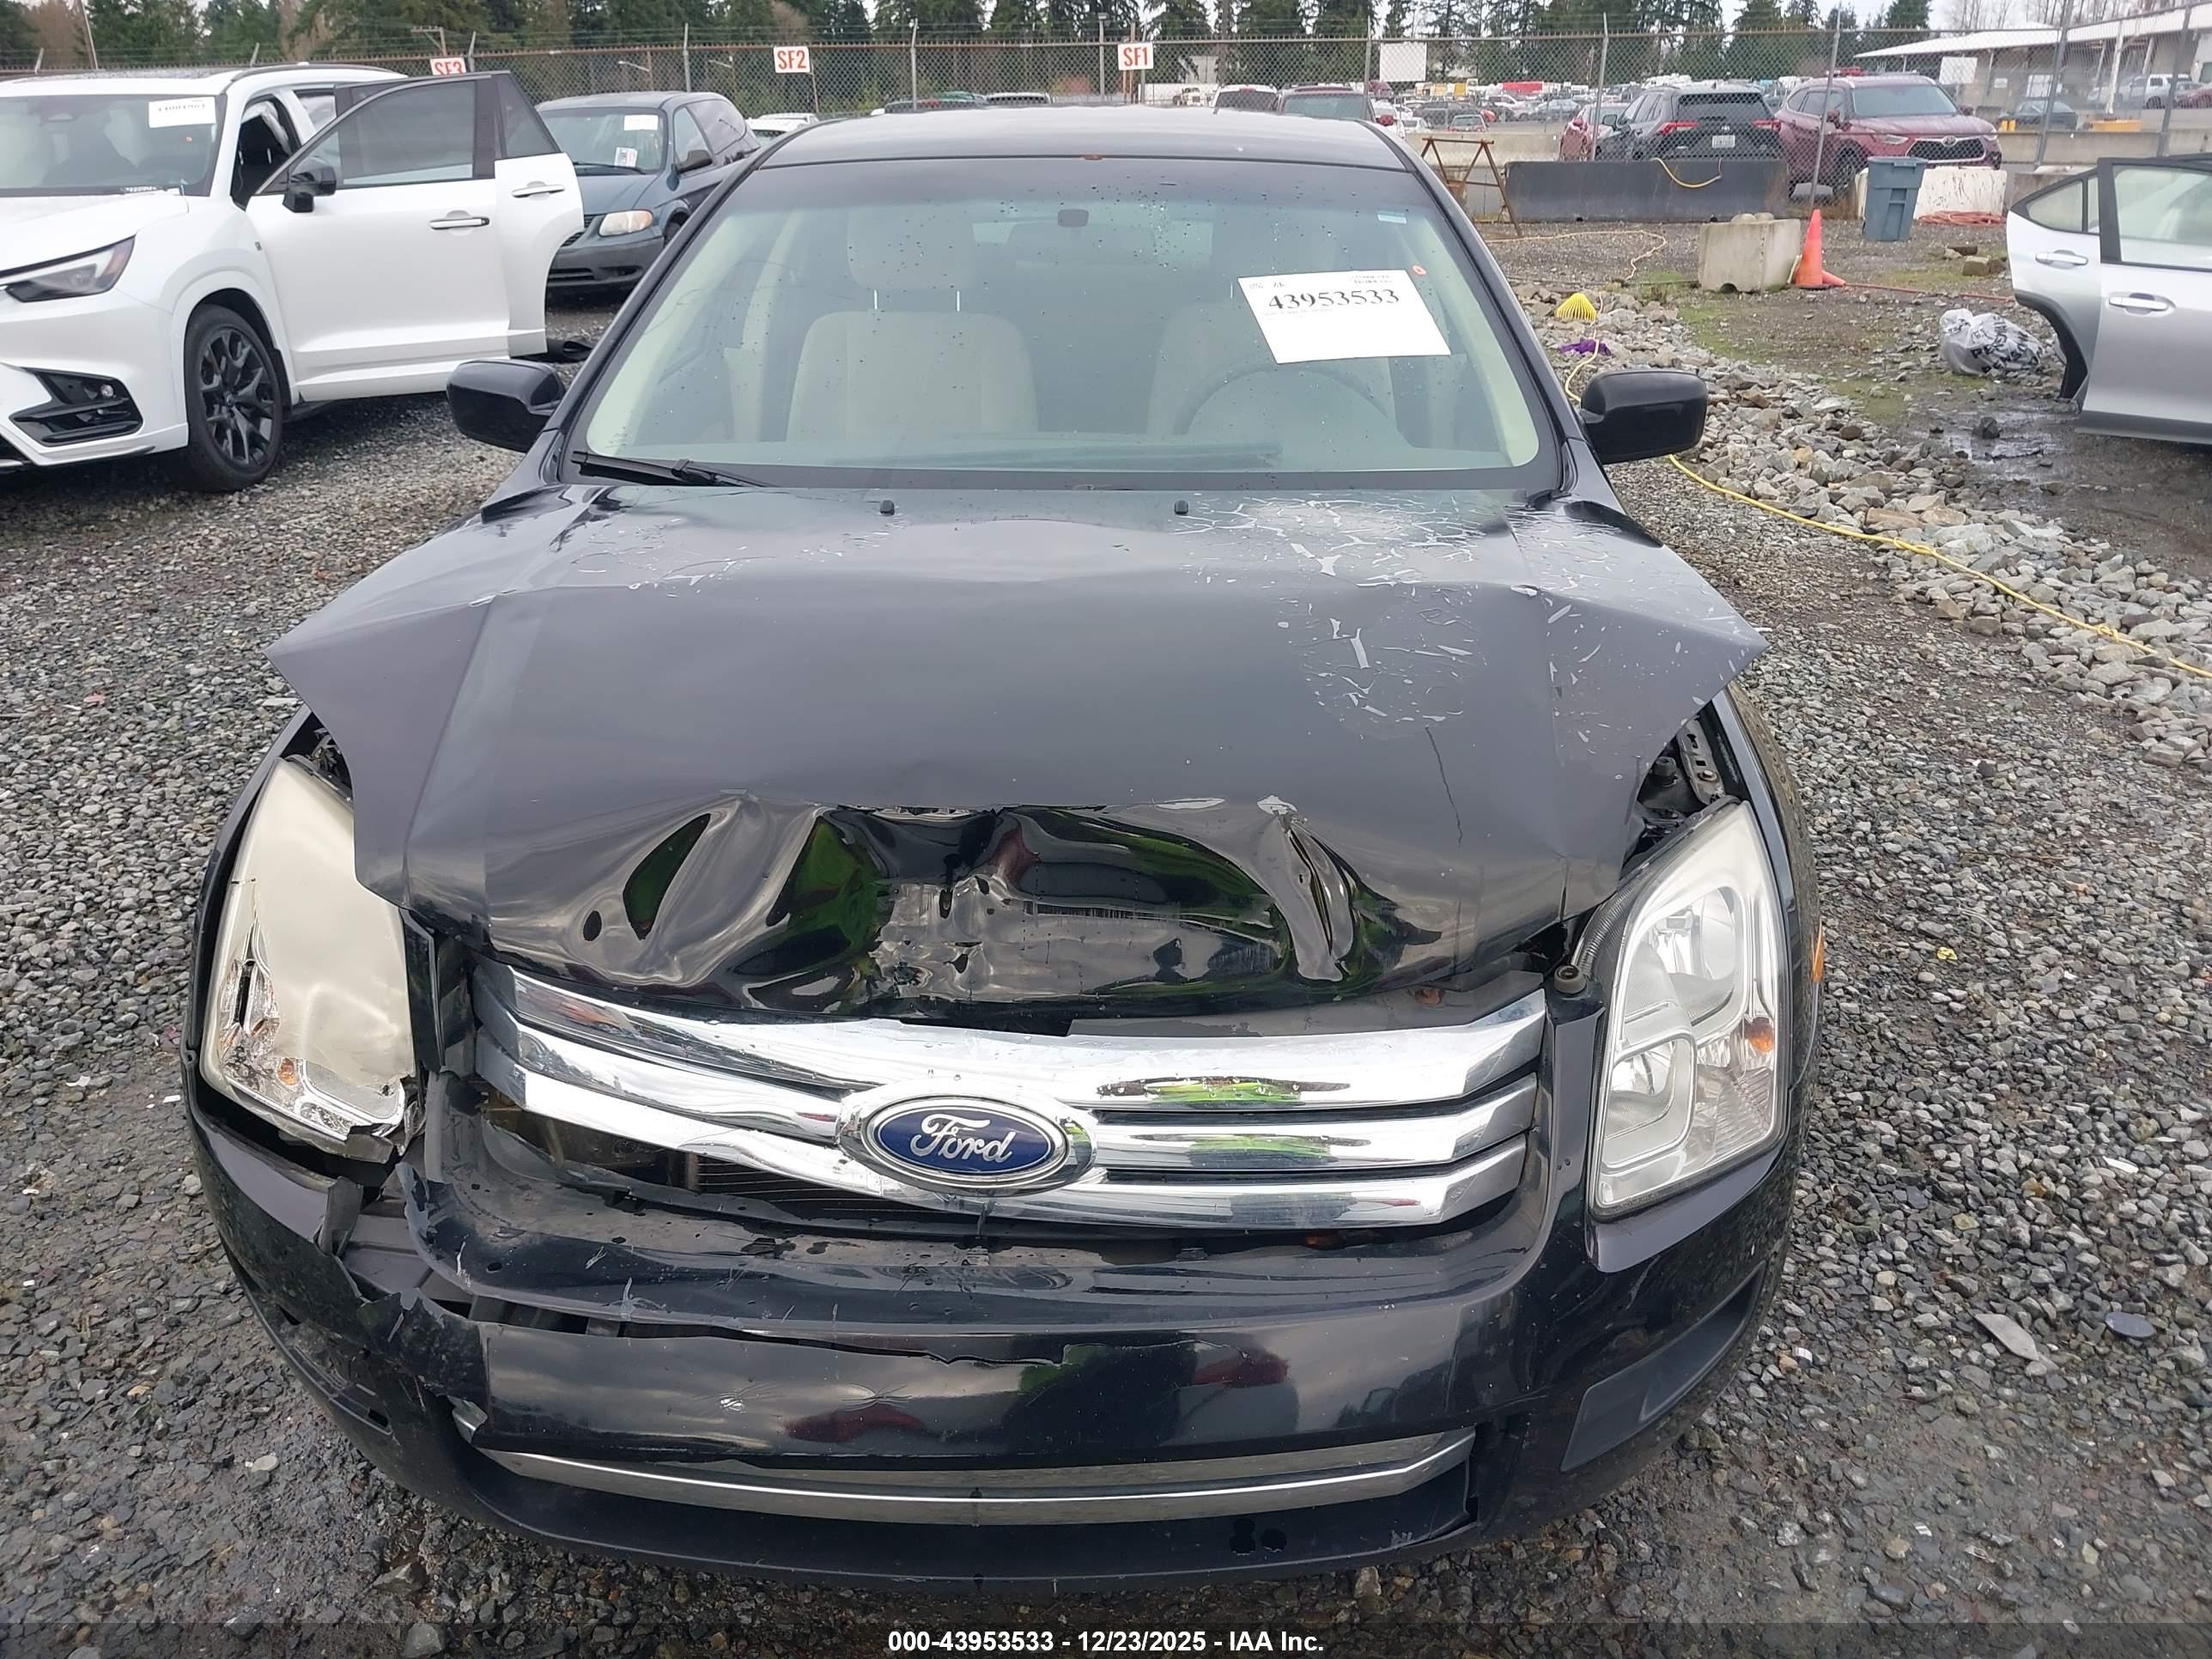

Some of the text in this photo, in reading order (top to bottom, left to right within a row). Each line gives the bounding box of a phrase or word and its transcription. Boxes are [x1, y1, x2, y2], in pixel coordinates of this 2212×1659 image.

[777, 50, 806, 70] SF2
[1123, 46, 1148, 66] SF1
[434, 61, 464, 76] SF3
[1268, 289, 1400, 310] 43953533
[909, 1113, 1016, 1164] Ford
